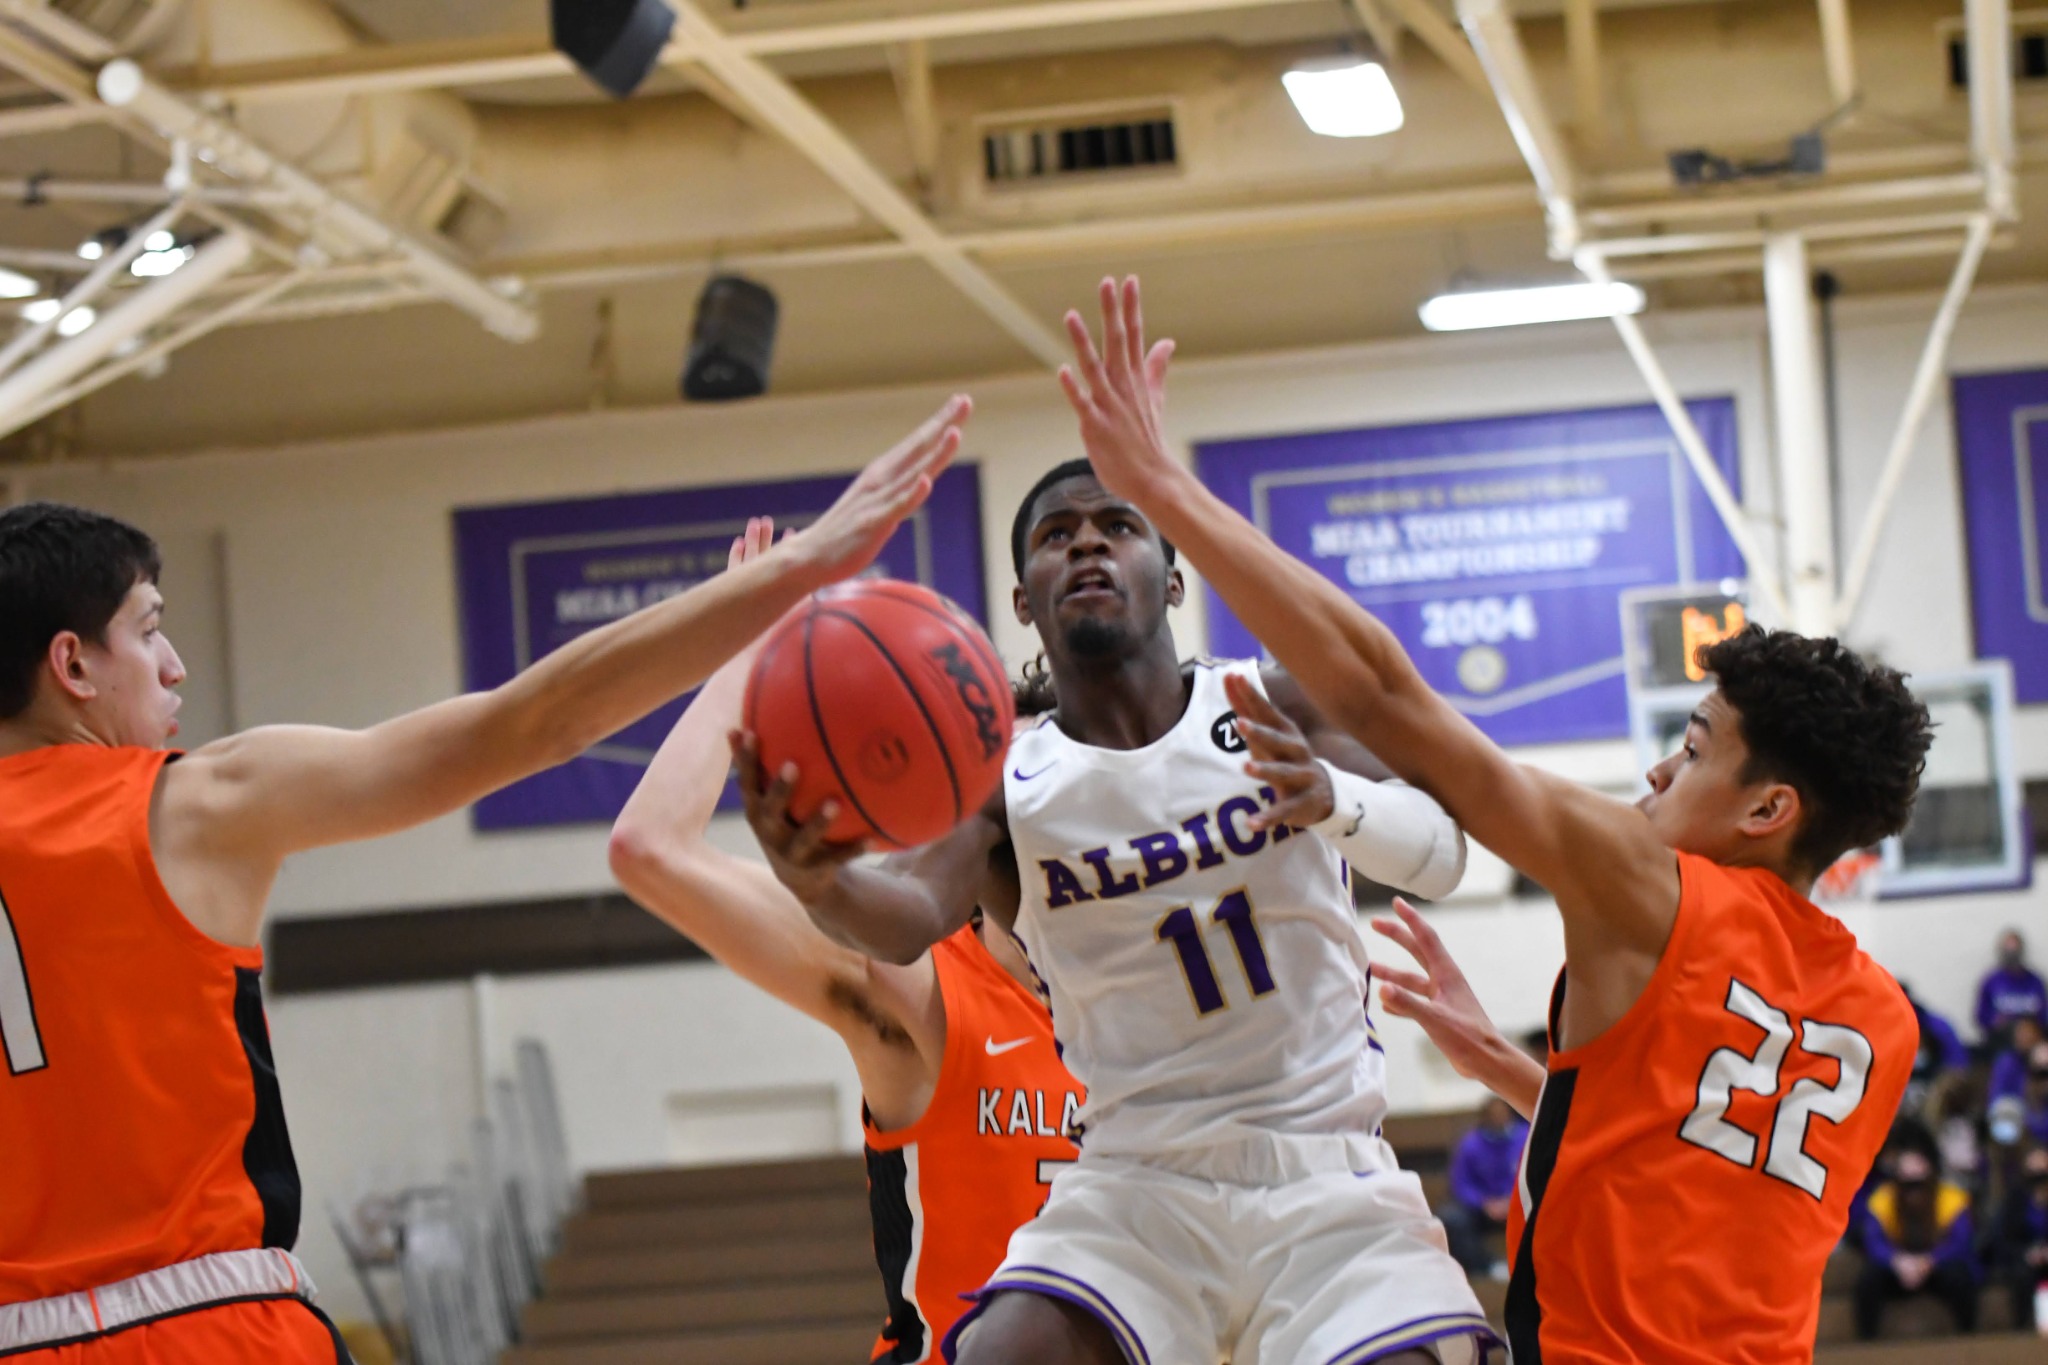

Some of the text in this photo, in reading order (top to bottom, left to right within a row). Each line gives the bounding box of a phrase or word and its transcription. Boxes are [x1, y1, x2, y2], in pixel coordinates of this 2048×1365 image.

[1454, 475, 1605, 504] BASKETBALL
[1311, 498, 1629, 557] MIAA TOURNAMENT
[1346, 537, 1599, 586] CHAMPIONSHIP
[1421, 595, 1538, 647] 2004
[931, 641, 1003, 762] NCAA
[1153, 885, 1279, 1020] 11
[1677, 976, 1874, 1203] 22
